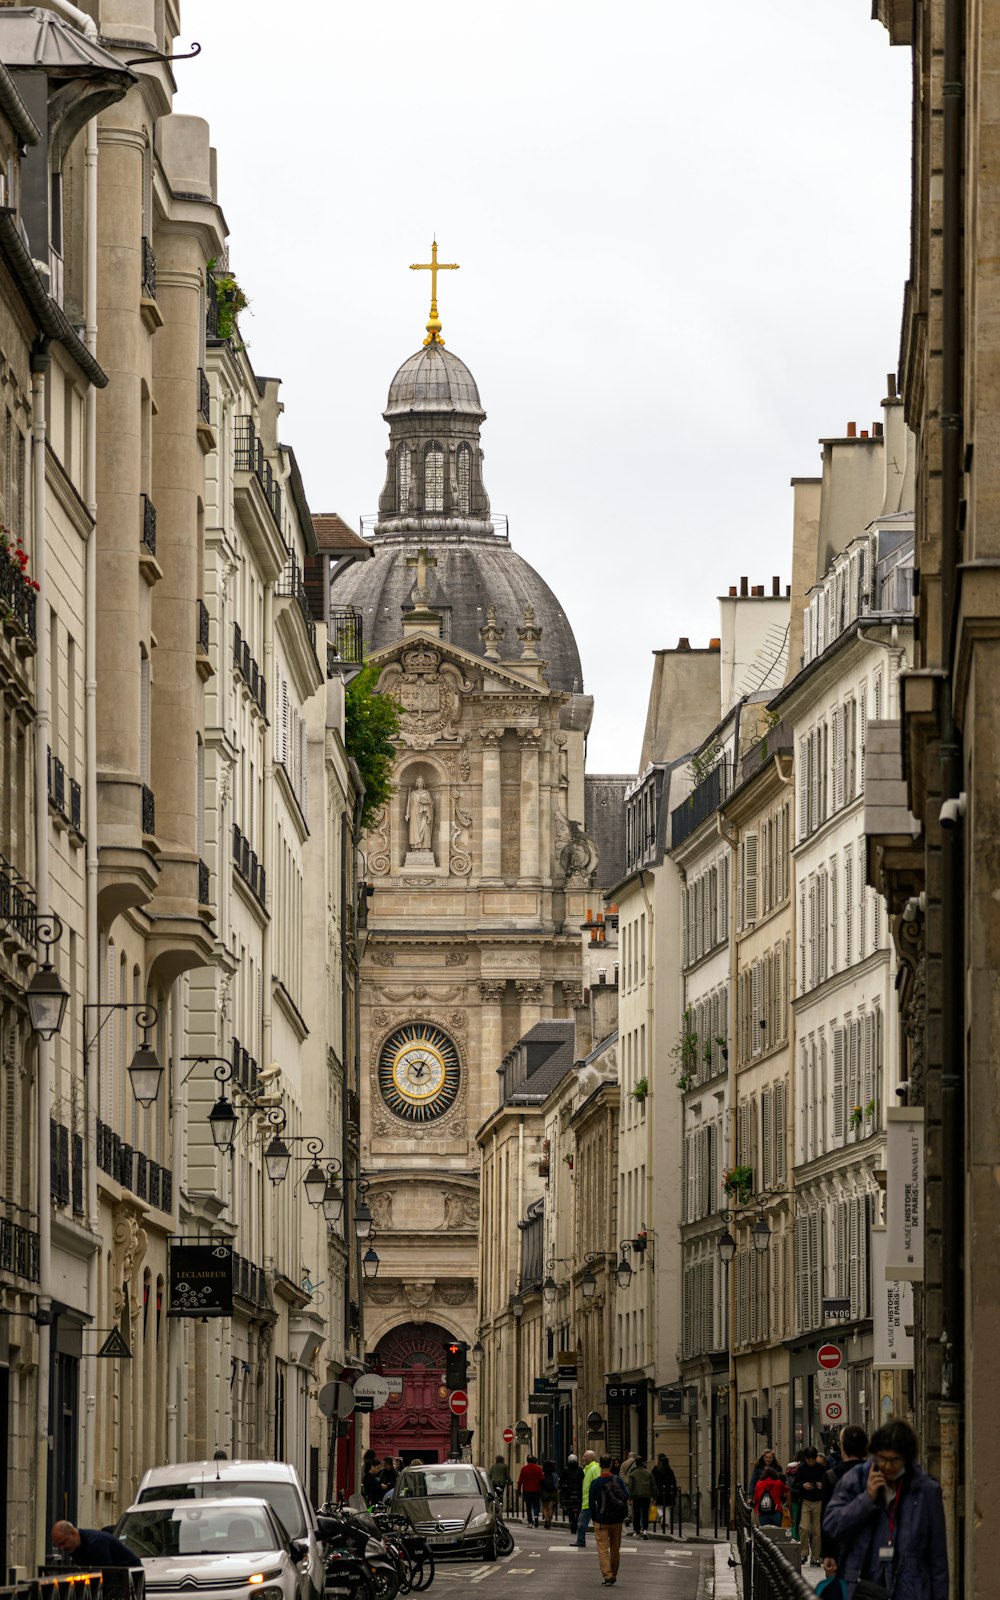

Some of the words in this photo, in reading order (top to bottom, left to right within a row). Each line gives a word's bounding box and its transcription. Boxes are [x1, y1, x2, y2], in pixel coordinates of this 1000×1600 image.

[912, 1215, 918, 1227] DE
[903, 1222, 911, 1250] MUSÉE
[824, 1309, 850, 1319] EKYOG
[894, 1317, 900, 1326] DE
[355, 1387, 376, 1395] bubble
[609, 1388, 637, 1397] GTF
[829, 1407, 839, 1415] 30
